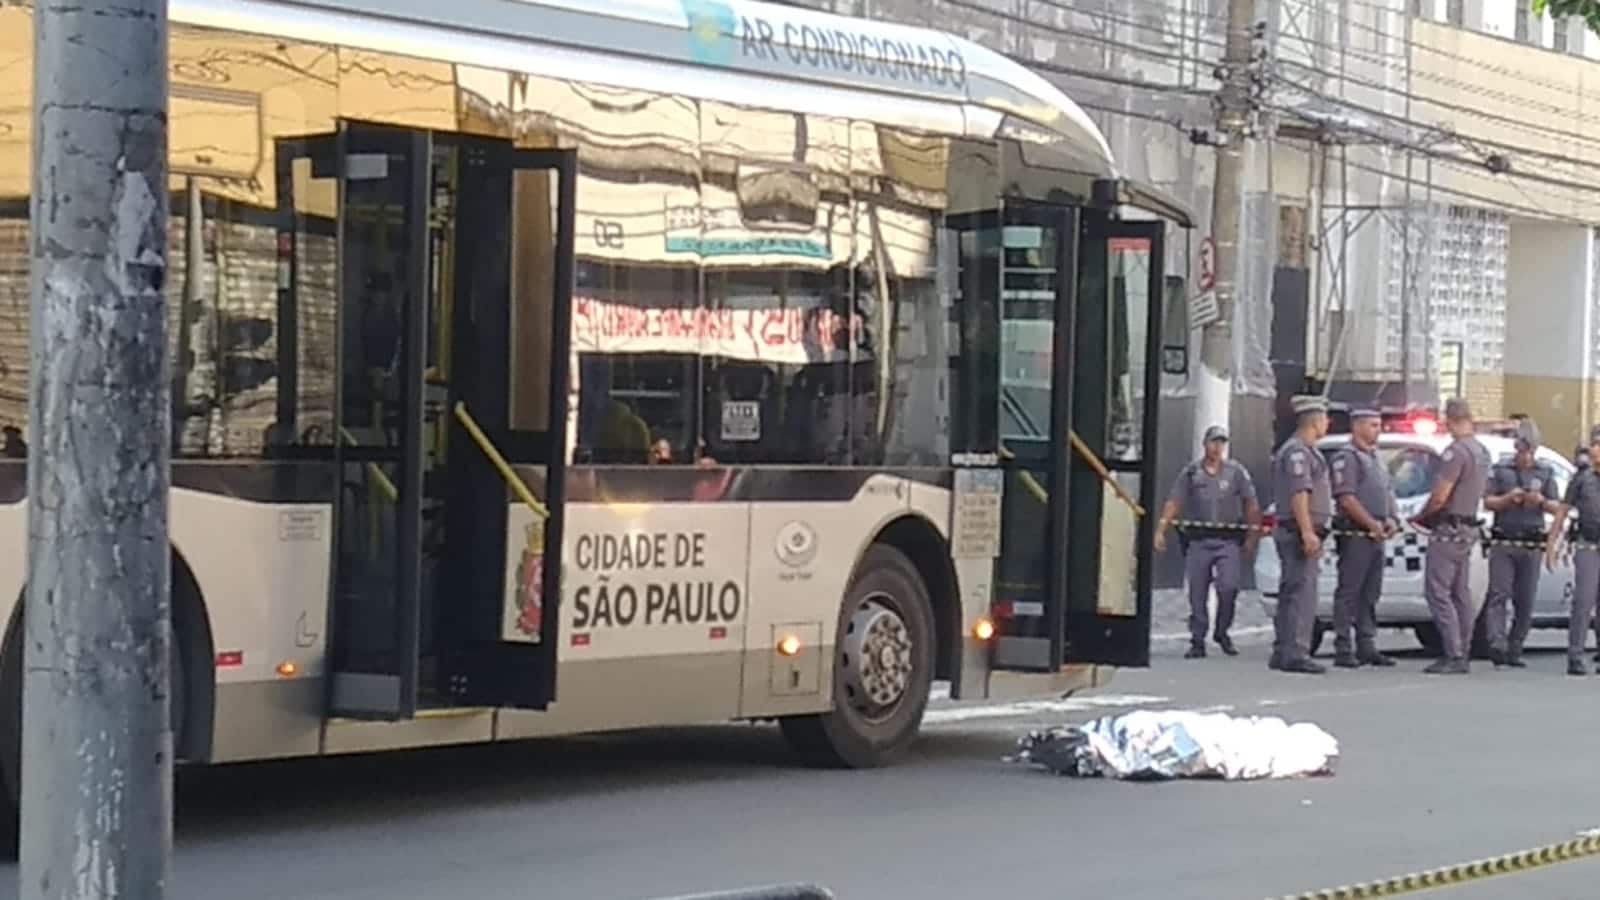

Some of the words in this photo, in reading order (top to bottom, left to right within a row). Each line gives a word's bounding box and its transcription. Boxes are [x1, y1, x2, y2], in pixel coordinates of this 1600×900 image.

[740, 17, 775, 62] AR
[785, 23, 966, 89] CONDICIONADO
[576, 533, 667, 571] CIDADE
[675, 532, 705, 567] DE
[573, 575, 637, 628] SÃO
[645, 581, 740, 625] PAULO
